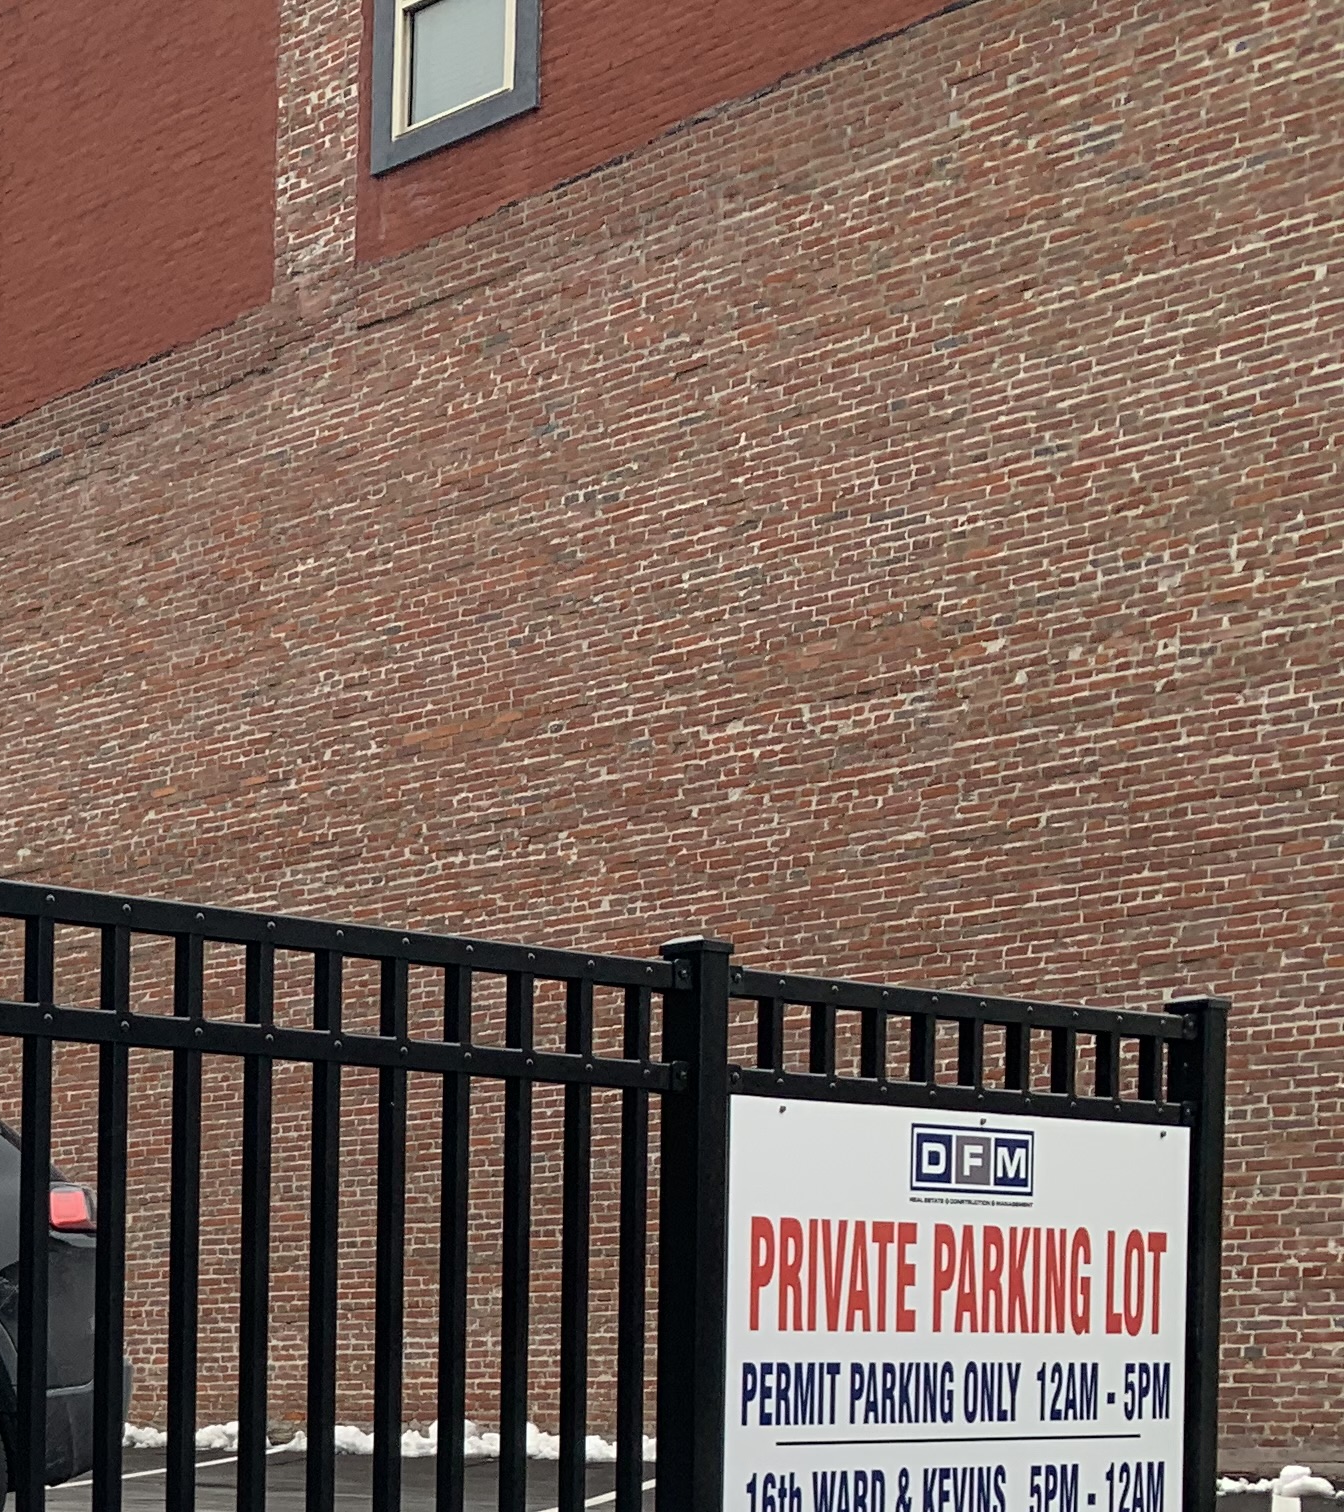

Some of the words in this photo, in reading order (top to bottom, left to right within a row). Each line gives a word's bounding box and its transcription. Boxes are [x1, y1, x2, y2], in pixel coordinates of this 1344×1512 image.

[921, 1142, 1026, 1179] DFM
[749, 1216, 918, 1333] PRIVATE
[932, 1223, 1092, 1336] PARKING
[1104, 1229, 1168, 1337] LOT
[741, 1362, 841, 1427] PERMIT
[849, 1360, 955, 1425] PARKING
[963, 1360, 1022, 1424] ONLY
[1036, 1361, 1099, 1422] 12AM
[1123, 1362, 1171, 1421] 5PM
